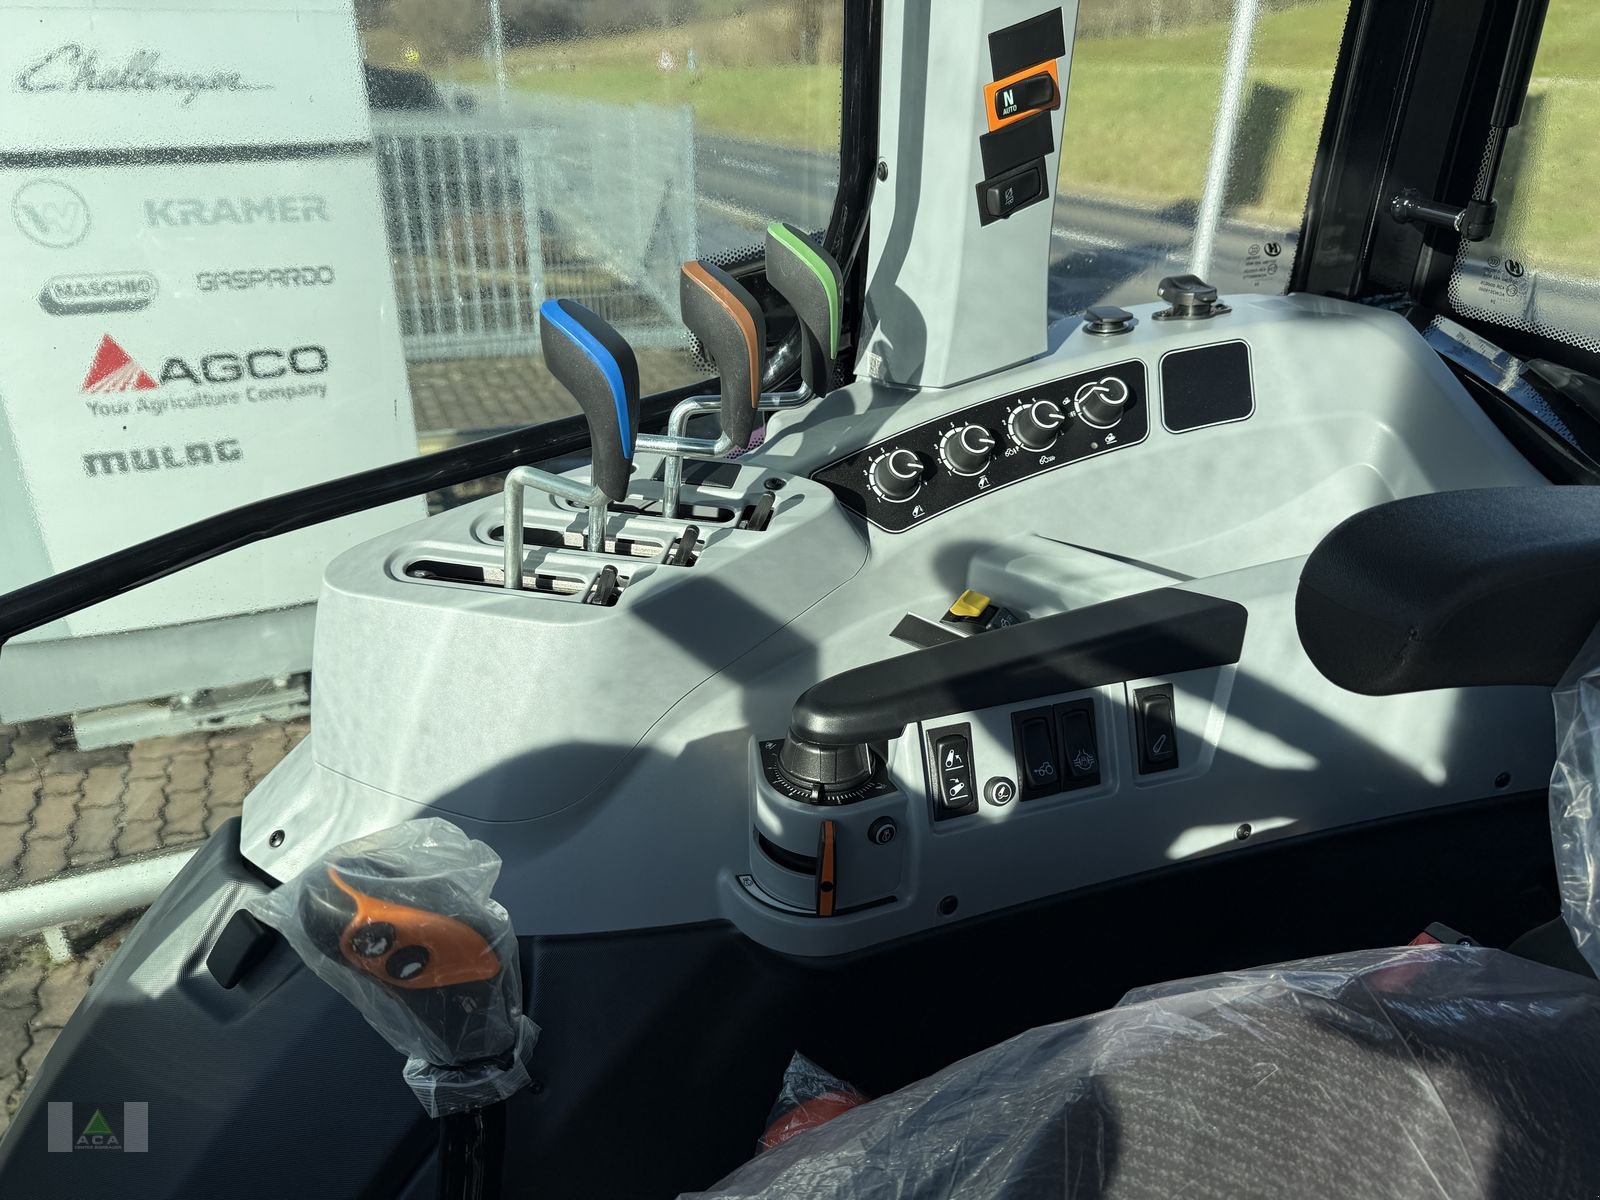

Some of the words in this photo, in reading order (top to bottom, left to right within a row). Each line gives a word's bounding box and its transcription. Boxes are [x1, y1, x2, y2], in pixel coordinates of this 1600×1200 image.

[1002, 104, 1018, 116] AUTO
[1003, 89, 1014, 107] N
[144, 195, 331, 226] KRAMER
[54, 279, 151, 298] MASCHIO
[196, 265, 335, 294] GASPARDO
[158, 345, 328, 385] AGCO
[86, 400, 131, 417] Your
[136, 391, 240, 415] Agriculture
[246, 382, 327, 403] Company
